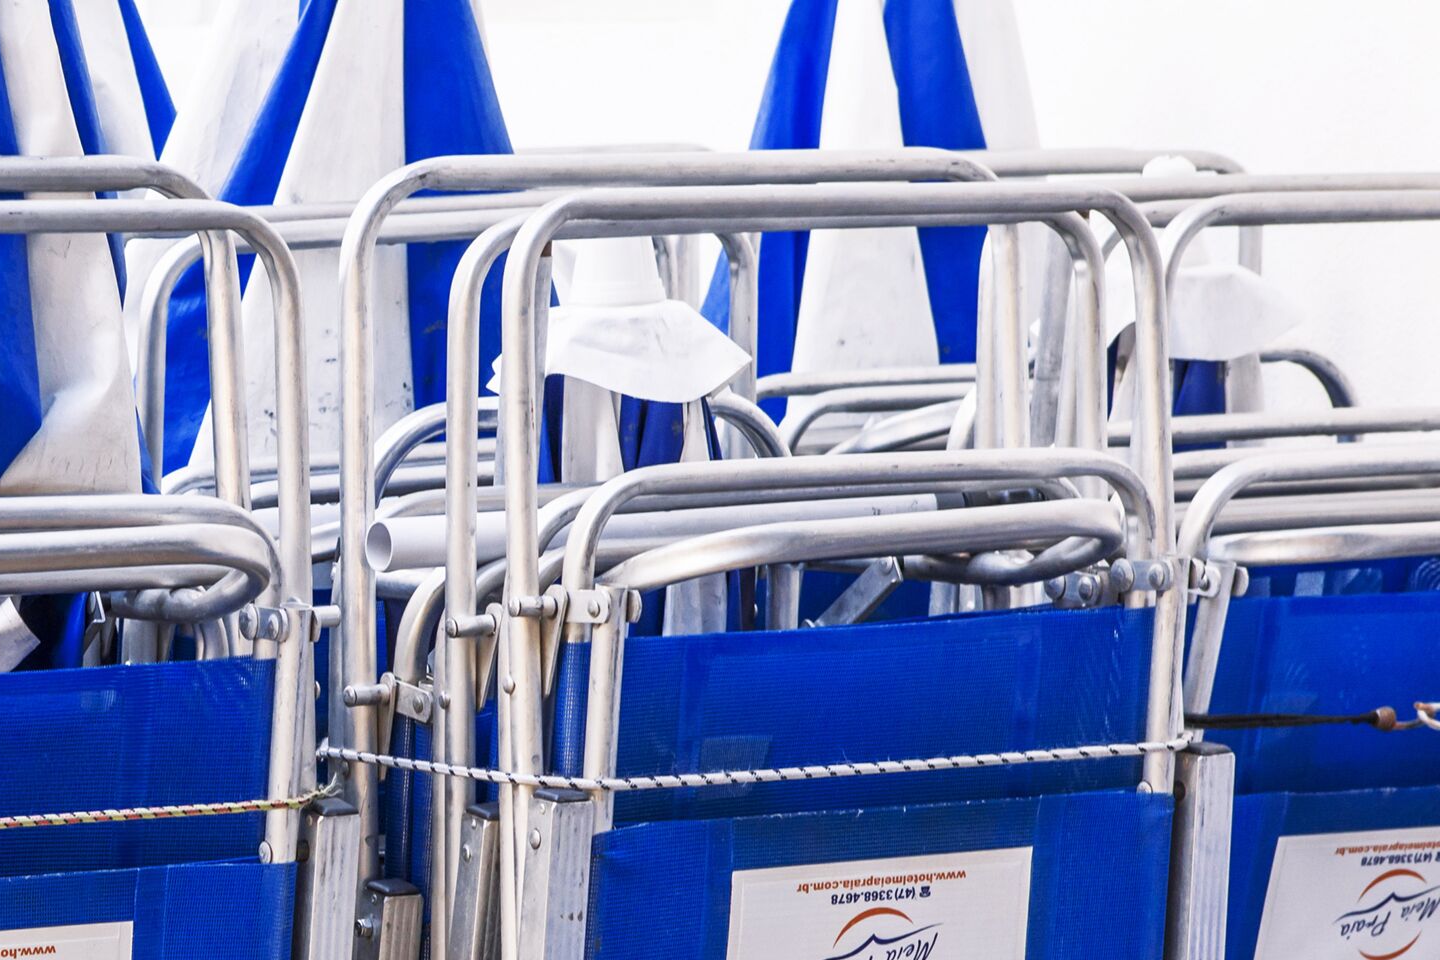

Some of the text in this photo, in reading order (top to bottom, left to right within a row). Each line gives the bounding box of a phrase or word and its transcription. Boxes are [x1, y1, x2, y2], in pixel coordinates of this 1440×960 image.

[797, 870, 967, 893] www.hotelmeiapraia.com.br
[1340, 897, 1440, 940] Meia Praia
